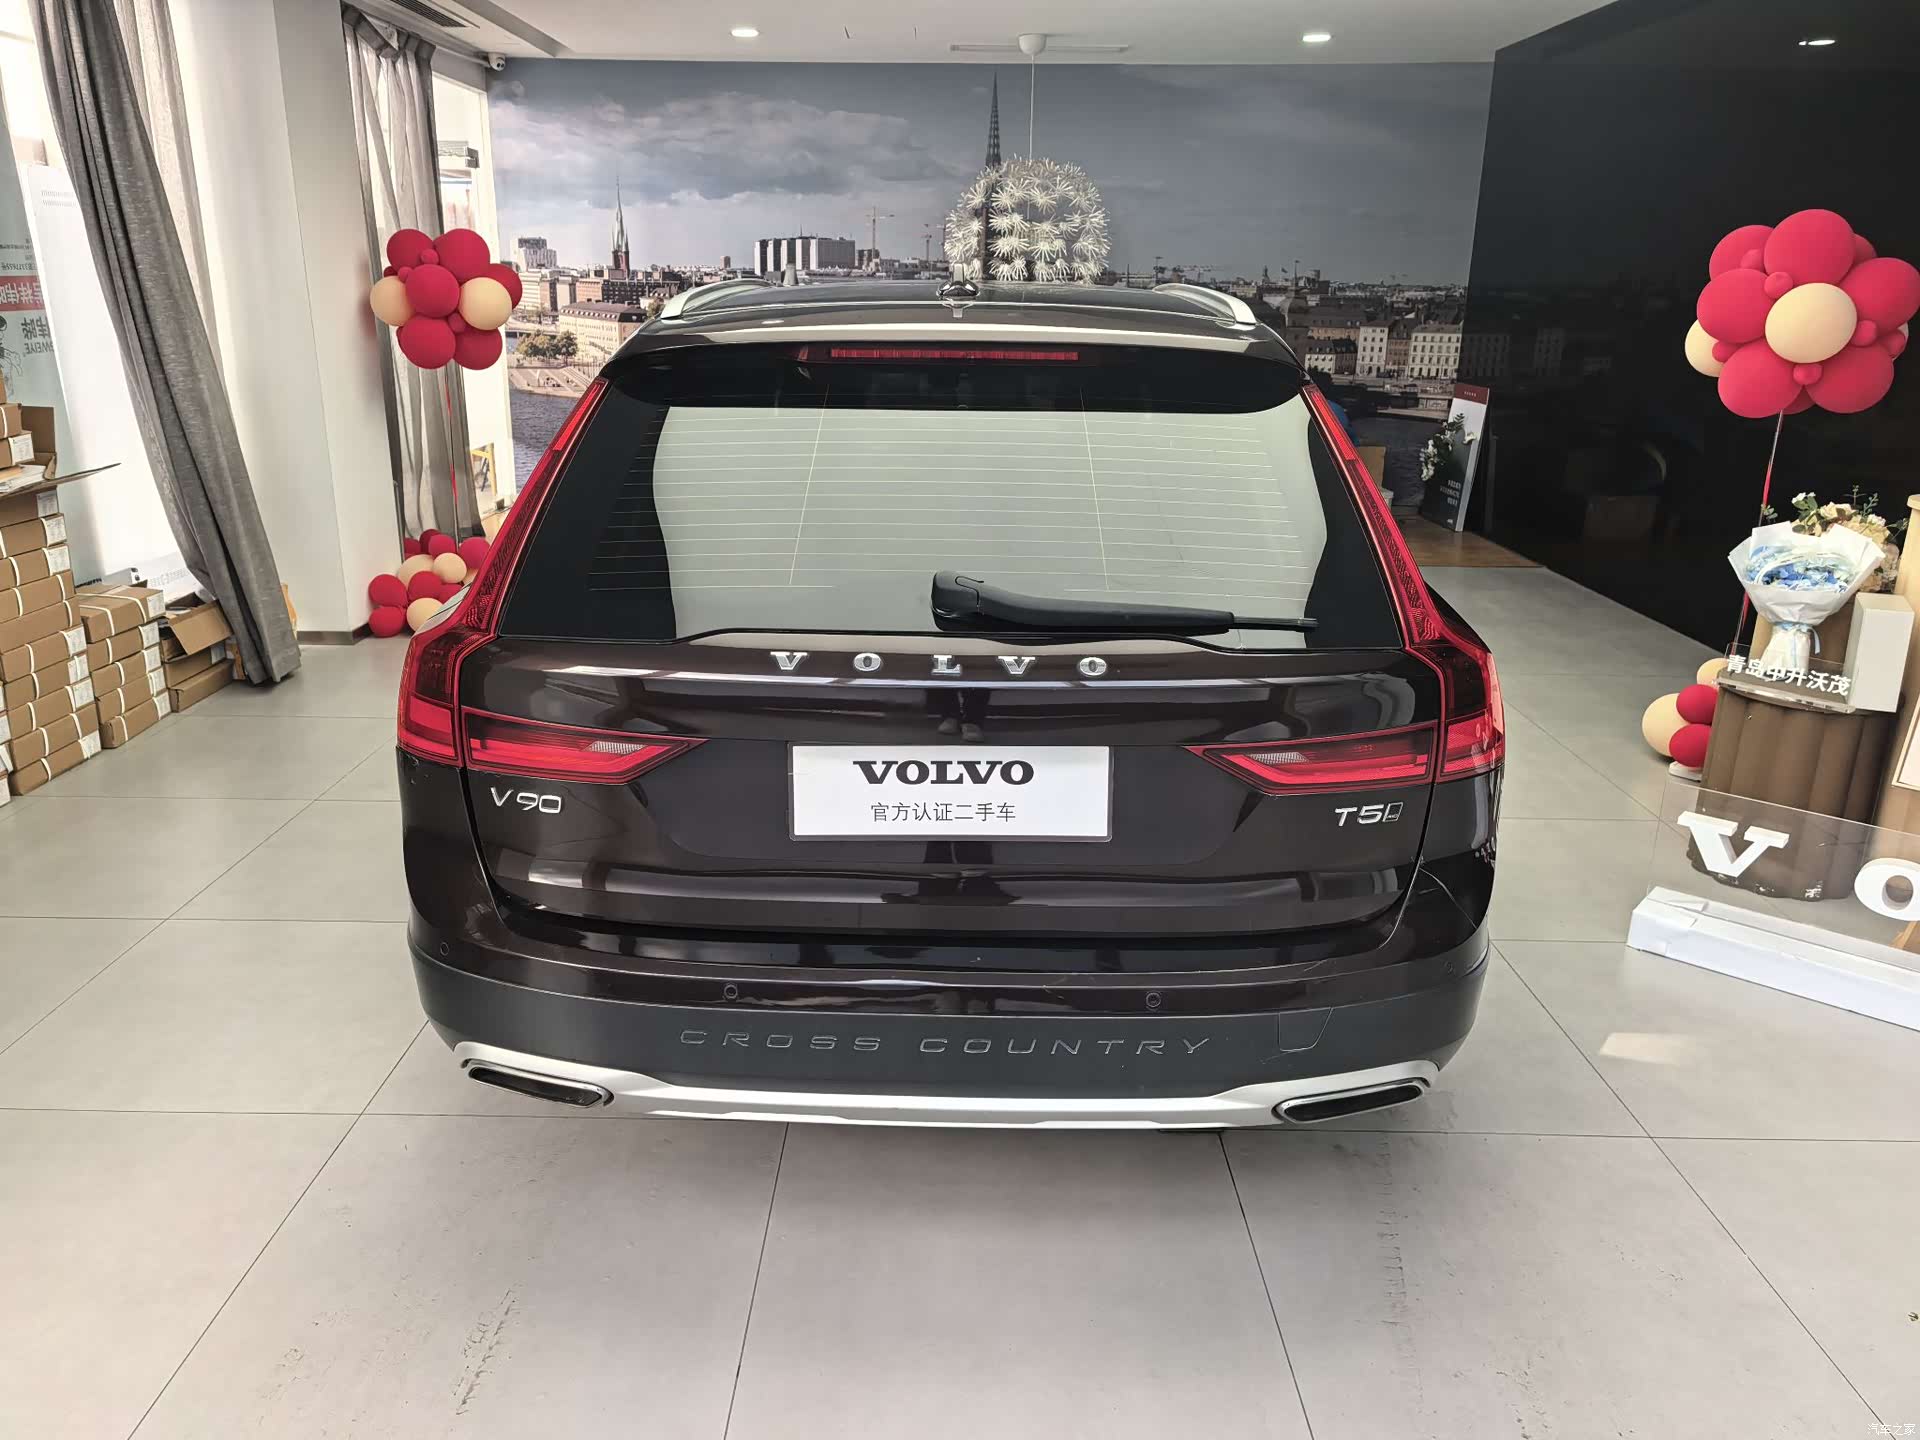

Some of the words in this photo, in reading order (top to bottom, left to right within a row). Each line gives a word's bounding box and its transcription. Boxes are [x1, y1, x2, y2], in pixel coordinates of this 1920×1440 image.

[770, 651, 1107, 677] VOLVO
[1726, 654, 1851, 697] 青岛中升沃茂
[852, 760, 1034, 785] VOLVO
[870, 802, 1016, 822] 官方认证二手车
[680, 1030, 881, 1051] CROSS
[919, 1038, 1209, 1055] COUNTRY
